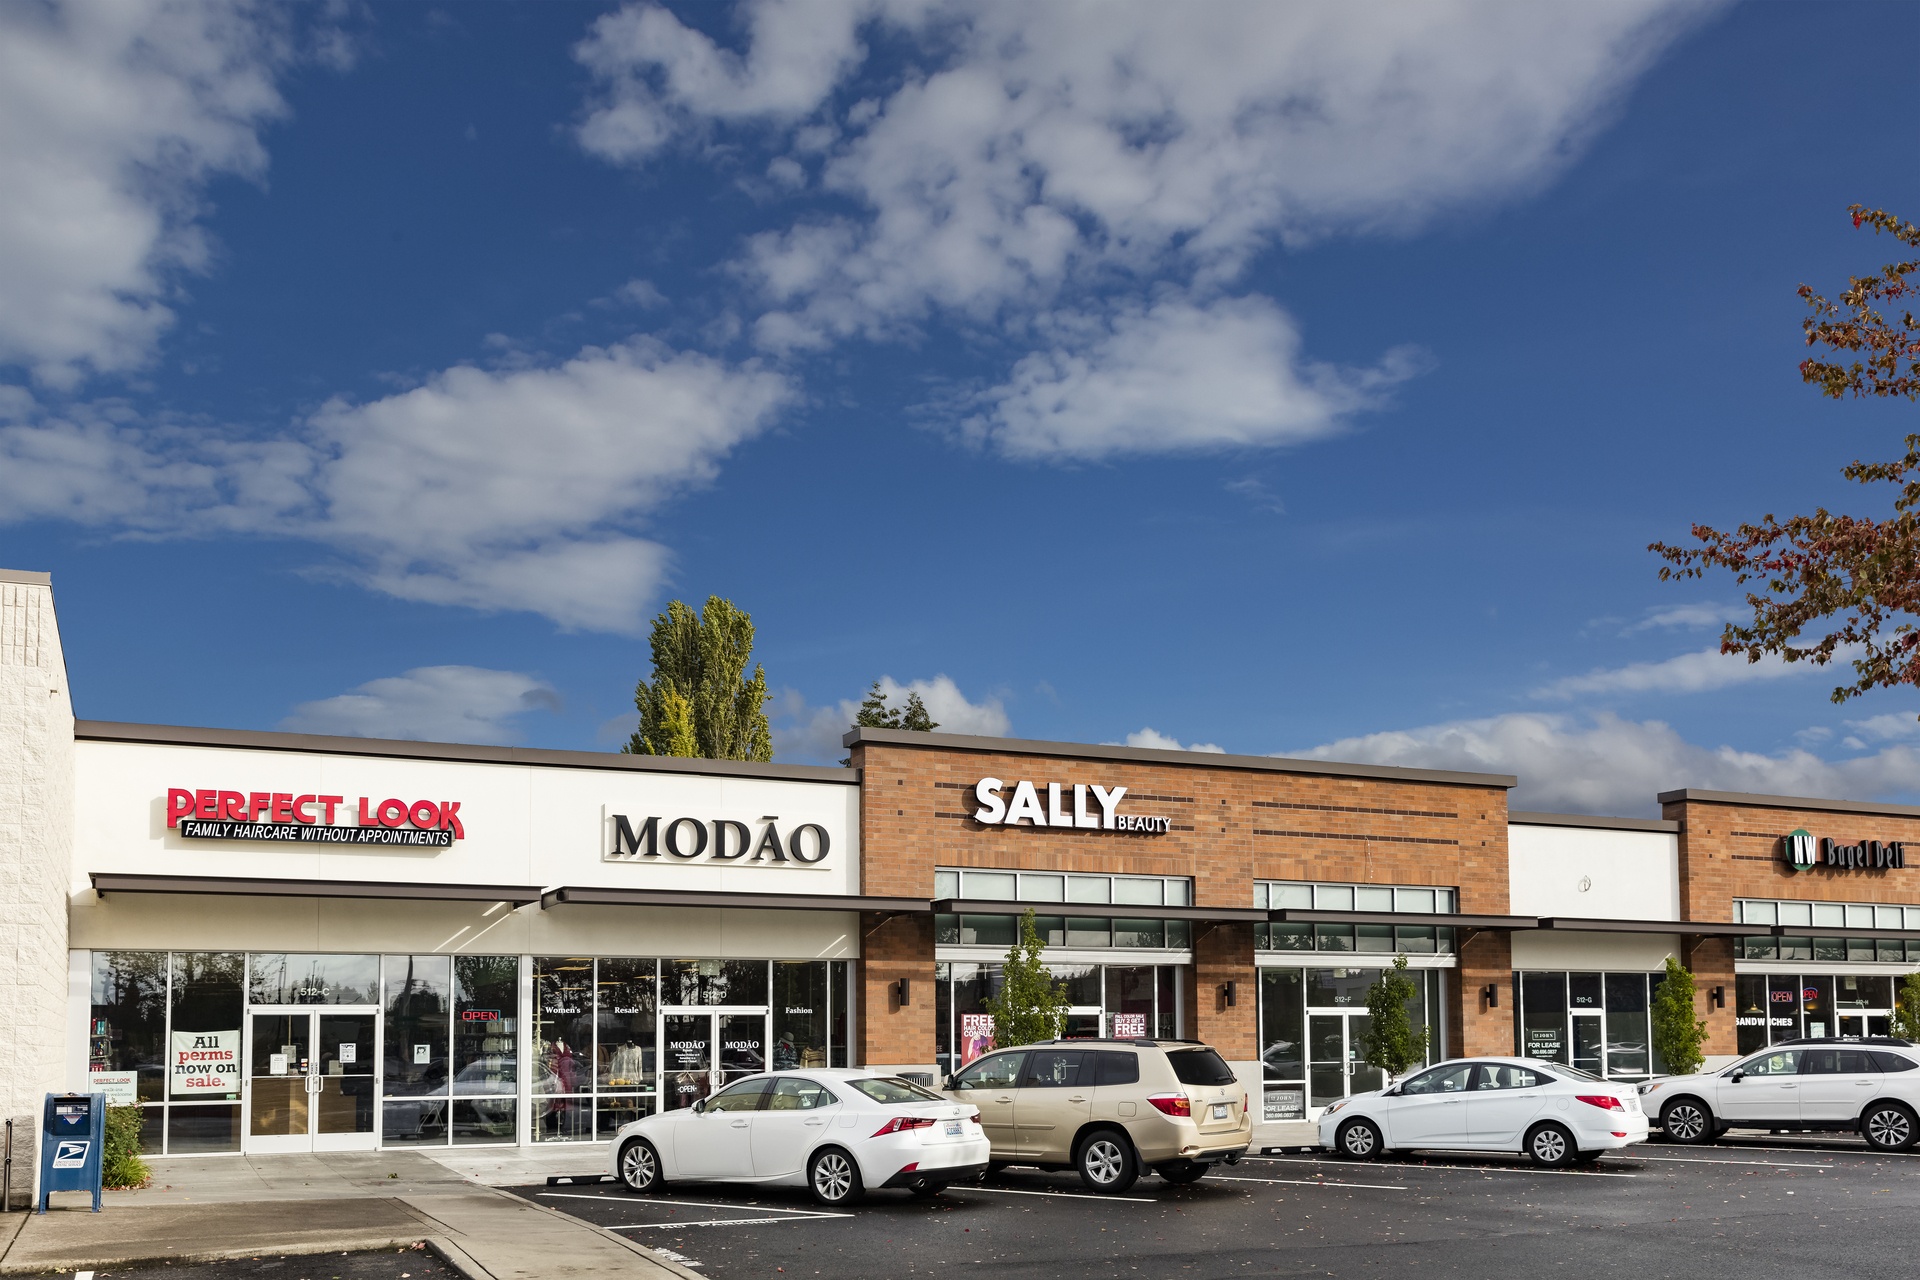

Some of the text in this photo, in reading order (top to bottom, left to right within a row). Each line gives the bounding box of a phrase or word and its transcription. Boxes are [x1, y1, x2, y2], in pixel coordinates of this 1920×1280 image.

[974, 777, 1172, 832] SALLY BEAUTY
[167, 787, 465, 840] PERFECT LOOK
[185, 822, 449, 845] FAMILY HAIRCARE WITHOUT APPOINTMENTS
[1792, 835, 1905, 870] NW Bagel Deli
[300, 987, 330, 997] 512-C
[1772, 992, 1792, 1001] OPEN
[1576, 996, 1592, 1004] 512-G
[462, 1011, 498, 1020] OPEN
[545, 1006, 581, 1014] Women's
[614, 1006, 639, 1014] Resale
[785, 1006, 813, 1014] Fashion
[963, 1014, 995, 1026] FREE
[1115, 1023, 1145, 1034] FREE
[193, 1036, 220, 1048] All
[178, 1050, 233, 1064] perms
[175, 1063, 237, 1074] now on
[186, 1074, 225, 1087] sale.
